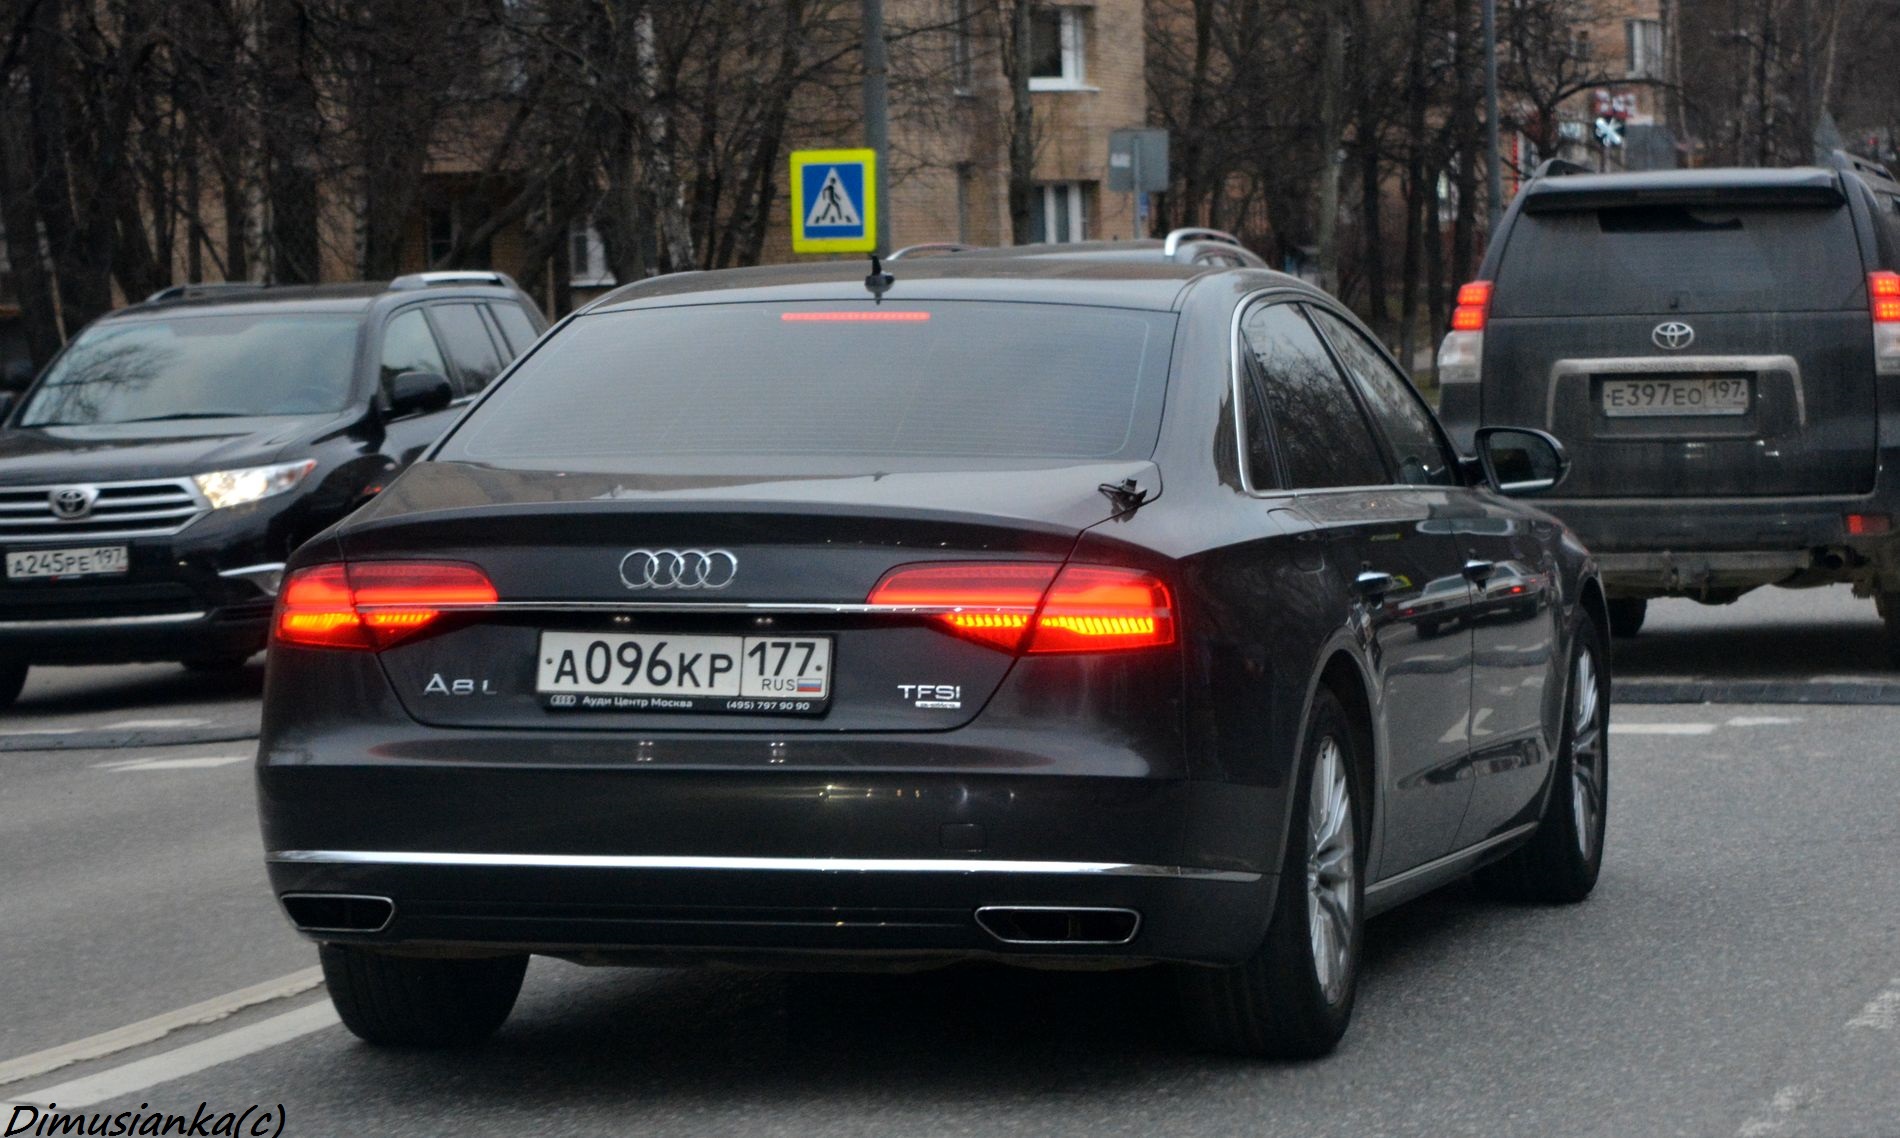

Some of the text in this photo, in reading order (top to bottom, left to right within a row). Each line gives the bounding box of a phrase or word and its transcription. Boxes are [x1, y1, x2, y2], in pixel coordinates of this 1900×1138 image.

[1611, 380, 1742, 407] Е397ЕО 197
[14, 548, 122, 575] А245РЕ 197
[554, 640, 816, 688] А096КР 177
[423, 673, 498, 696] A8 L
[761, 678, 796, 692] RUS
[897, 685, 961, 700] TFSI
[582, 695, 693, 708] Ауди Центр Москва
[726, 701, 810, 710] (495) 797 90 90
